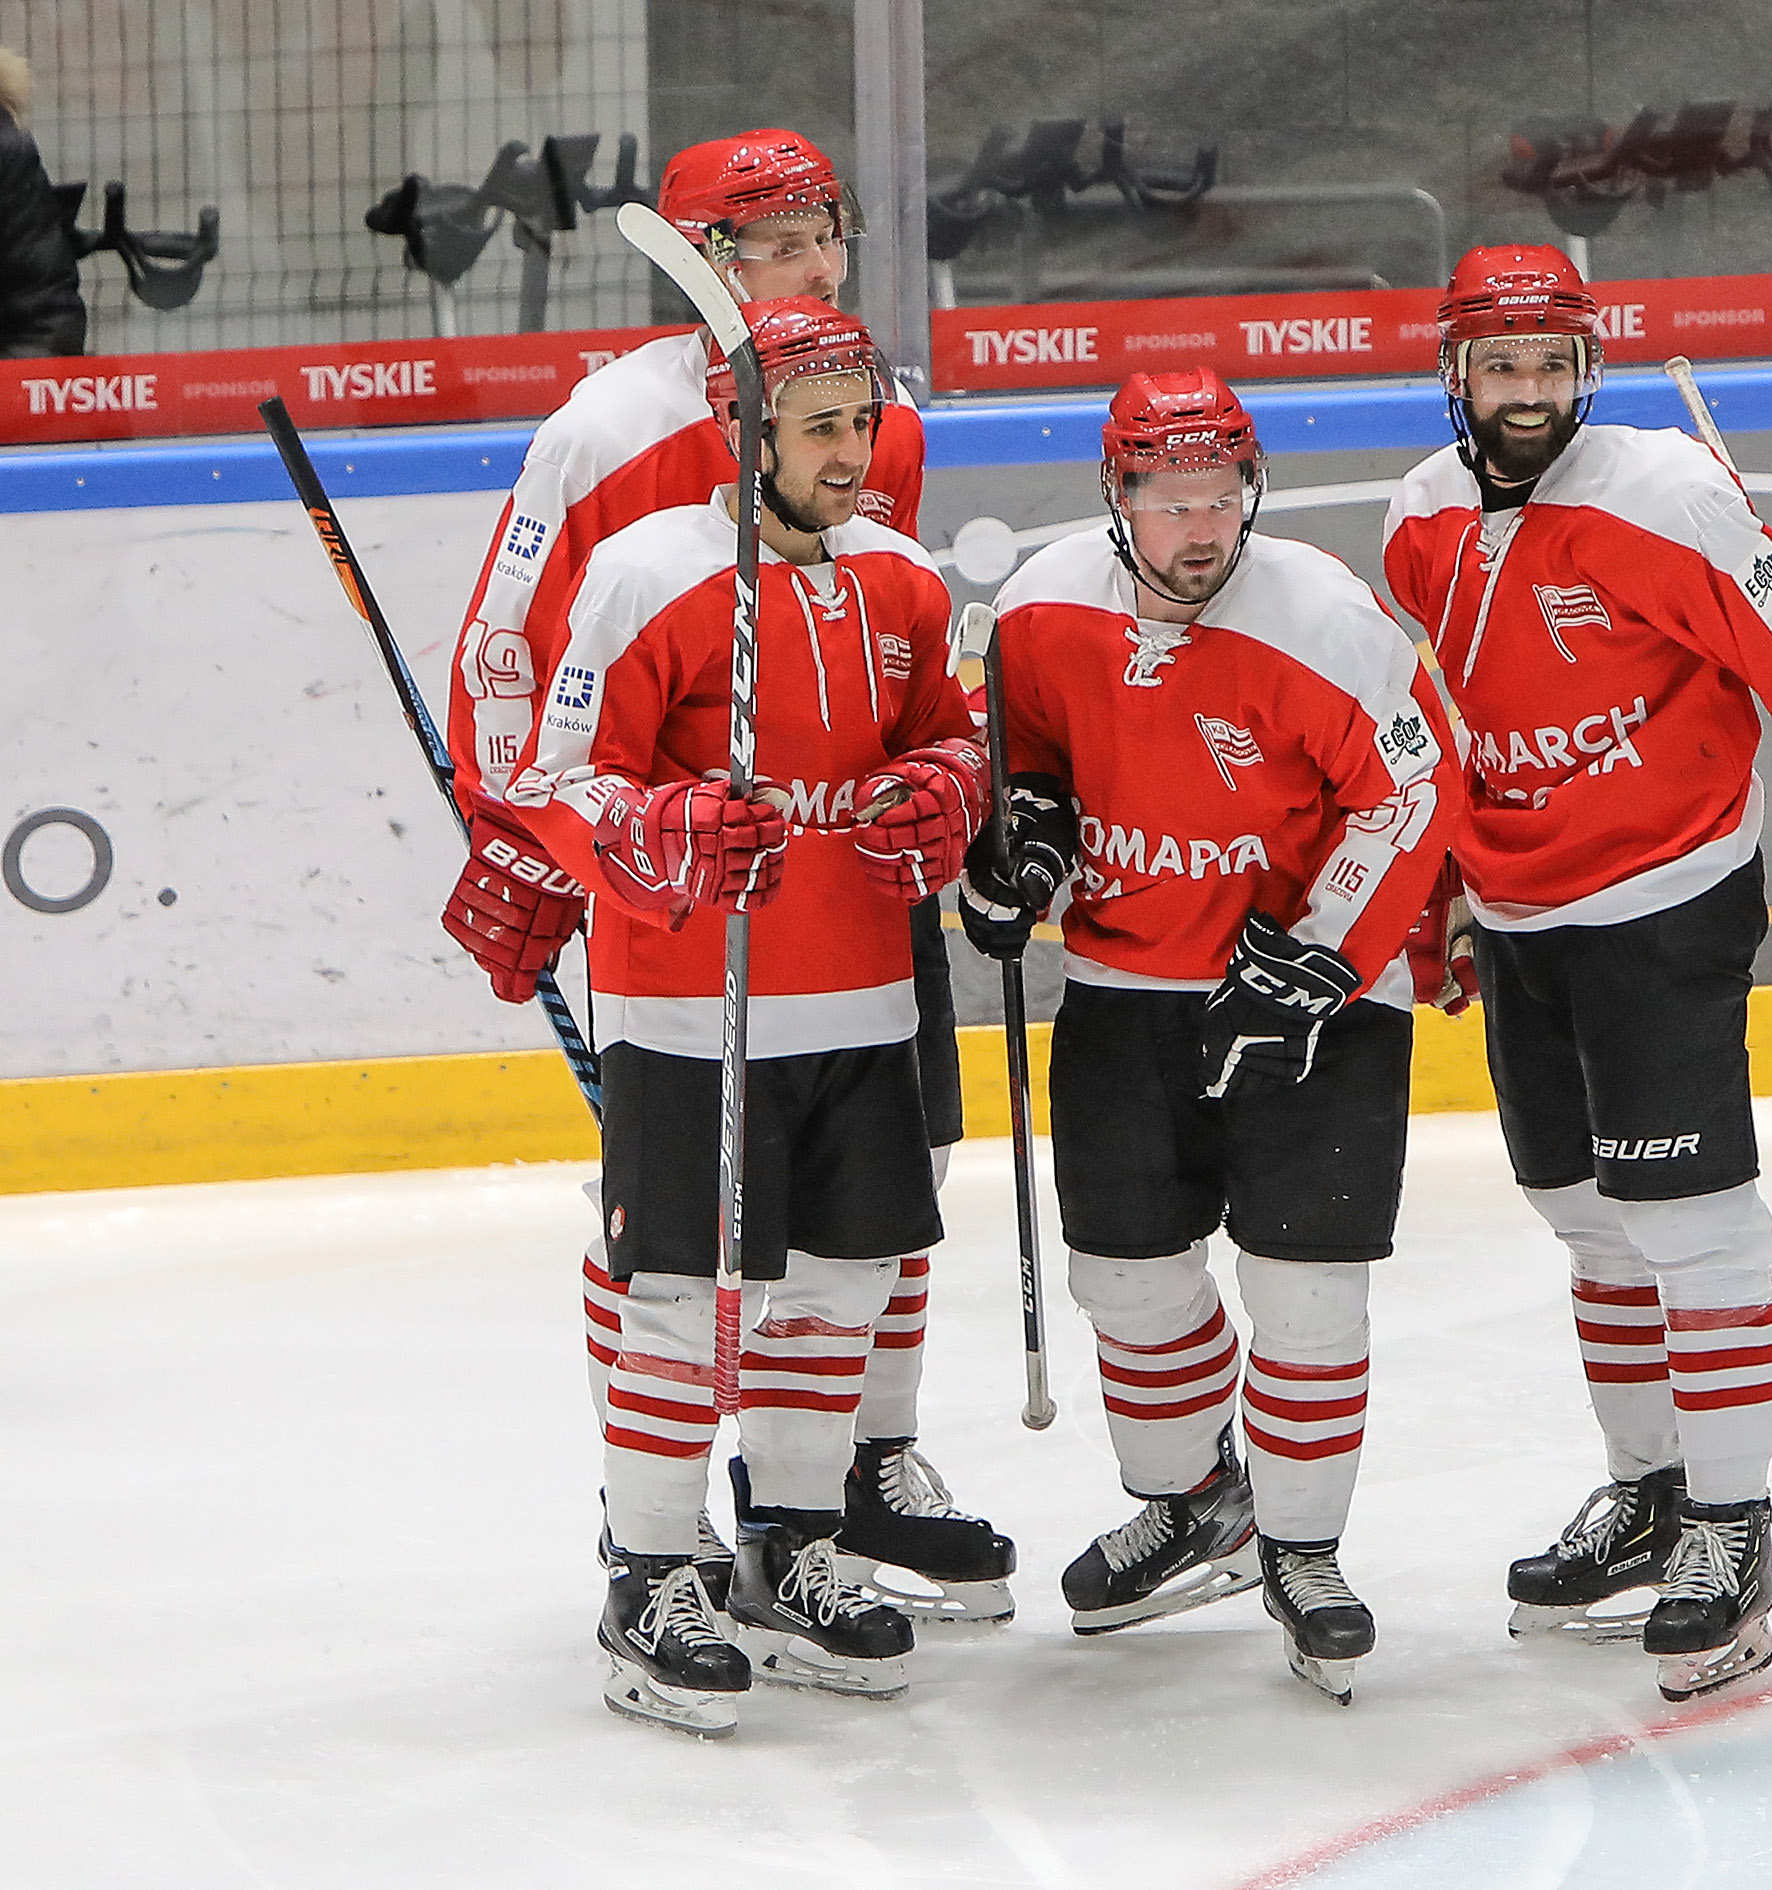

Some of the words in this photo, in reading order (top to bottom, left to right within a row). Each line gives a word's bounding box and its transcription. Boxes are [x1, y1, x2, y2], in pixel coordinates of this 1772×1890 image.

[1497, 294, 1550, 306] BAUER
[818, 331, 860, 345] BAUER
[965, 327, 1099, 366] TYSKIE
[1124, 333, 1217, 351] SPONSOR
[1239, 316, 1373, 355] TYSKIE
[1594, 304, 1646, 339] KIE
[1673, 308, 1766, 328] SPONSOR
[21, 374, 159, 415] TYSKIE
[300, 360, 438, 400] TYSKIE
[462, 365, 557, 382] SPONSOR
[1166, 430, 1217, 445] CCM
[496, 561, 534, 585] Kraków
[460, 617, 537, 700] 19
[730, 570, 757, 768] CCM
[488, 734, 517, 765] 115
[546, 713, 593, 735] Kraków
[1379, 721, 1416, 755] ECO
[1473, 695, 1648, 775] MARCH
[584, 777, 618, 807] 115
[629, 787, 657, 878] BAU
[481, 837, 586, 898] BAU
[1329, 856, 1370, 893] 115
[1238, 958, 1335, 1016] CM
[718, 969, 738, 1188] JETSPEED
[1591, 1132, 1701, 1160] BAUER
[732, 1181, 744, 1240] CCM
[1023, 1255, 1034, 1314] CCM
